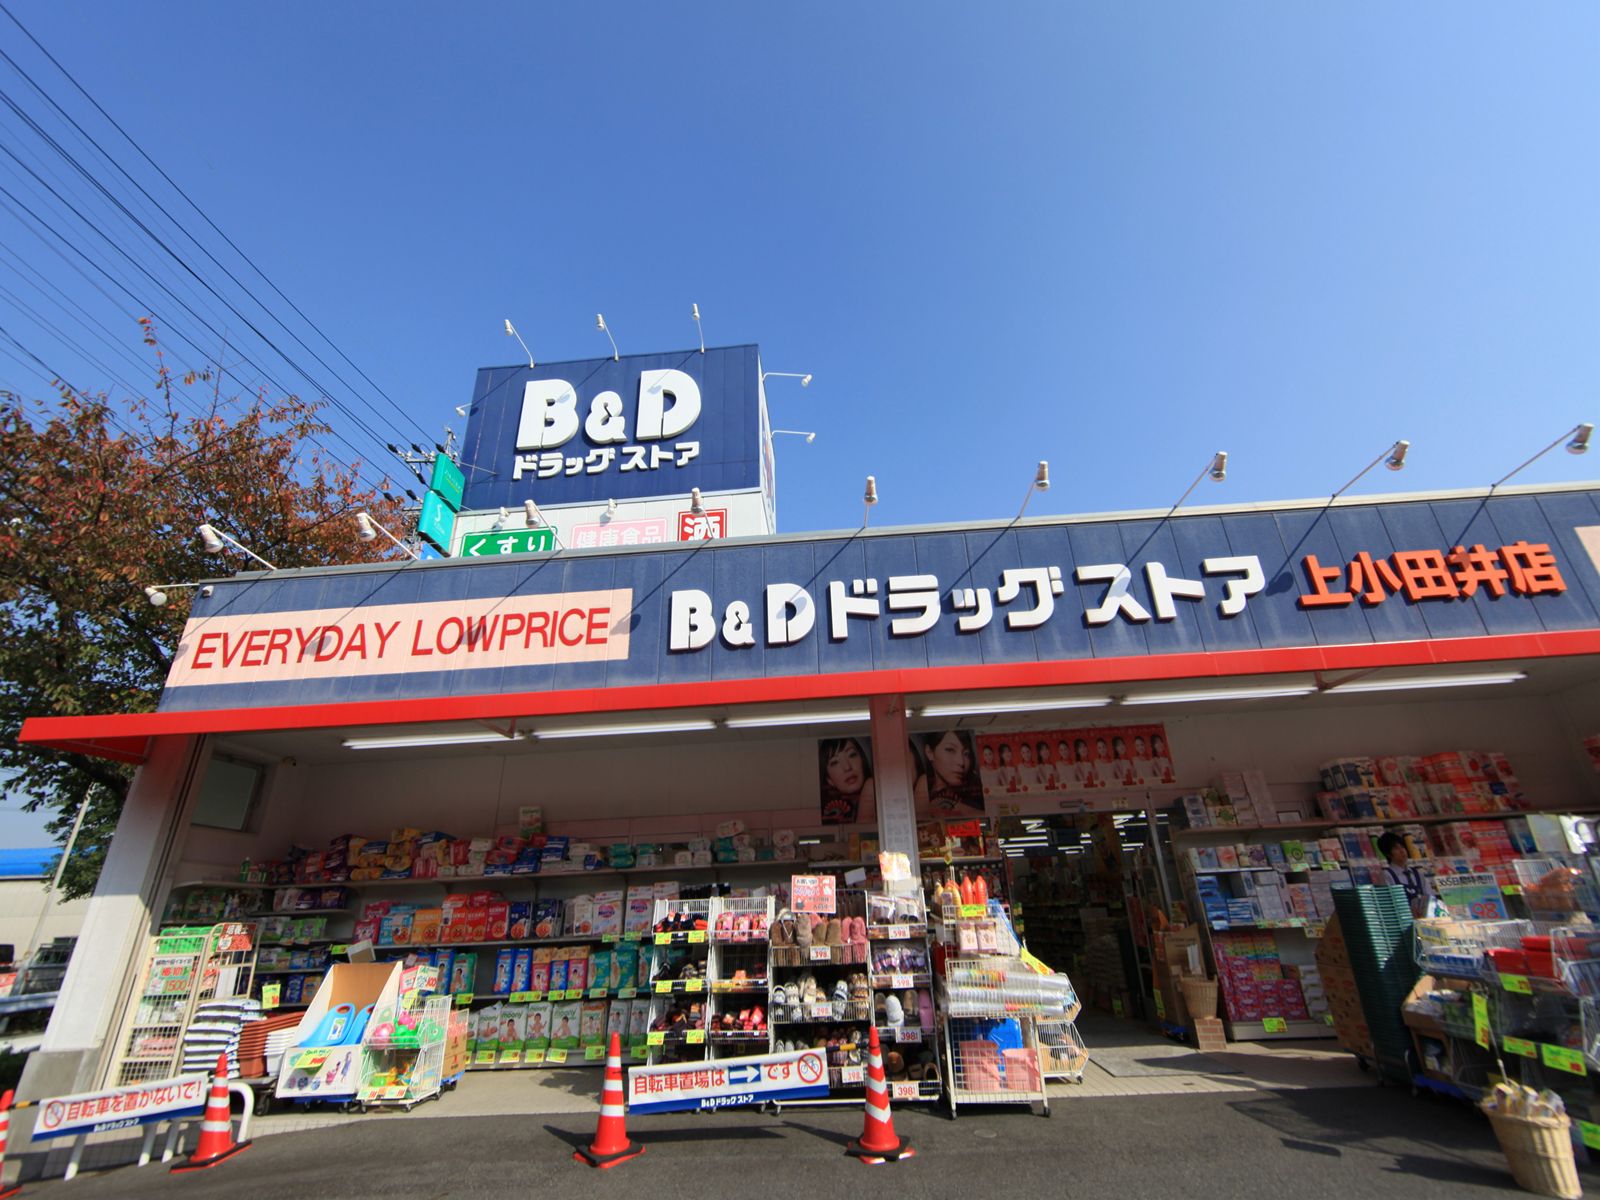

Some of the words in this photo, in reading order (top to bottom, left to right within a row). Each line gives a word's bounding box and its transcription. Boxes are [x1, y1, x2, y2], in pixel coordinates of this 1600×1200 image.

[516, 368, 702, 450] B&D
[512, 441, 700, 481] ドラッグストア
[468, 534, 546, 557] くすり
[576, 525, 667, 550] 健康食品
[1299, 540, 1567, 607] 上小田井店
[190, 620, 400, 669] EVERYDAY
[410, 606, 611, 657] LOWPRICE
[634, 1069, 726, 1095] 自転車置場は
[763, 1061, 794, 1081] です
